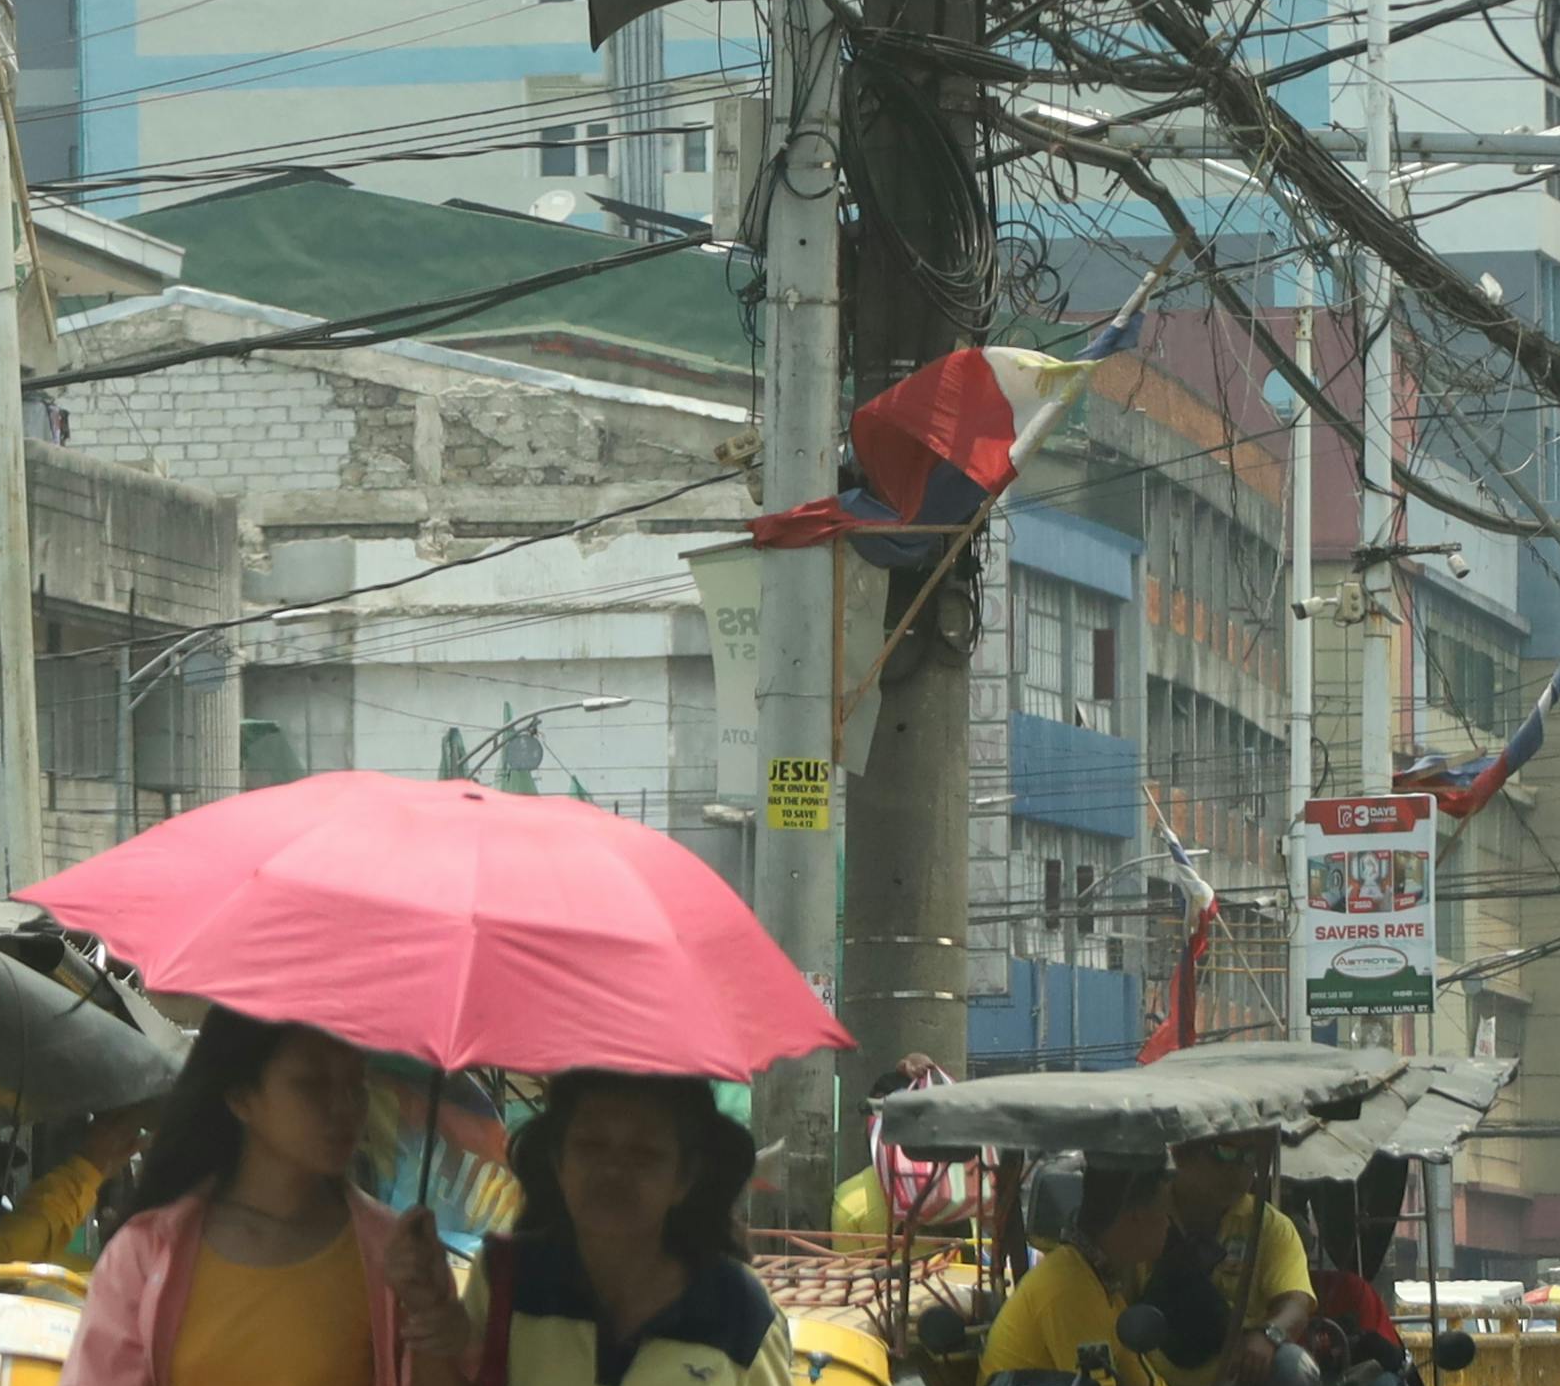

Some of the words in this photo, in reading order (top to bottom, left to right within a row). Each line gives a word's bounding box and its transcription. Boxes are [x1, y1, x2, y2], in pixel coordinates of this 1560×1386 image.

[769, 760, 829, 782] JESUS
[784, 797, 799, 806] THE
[782, 809, 792, 818] TO
[1354, 805, 1370, 827] 3
[1370, 806, 1397, 817] DAYS
[1315, 925, 1380, 941] SAVERS
[1384, 923, 1424, 938] RATE
